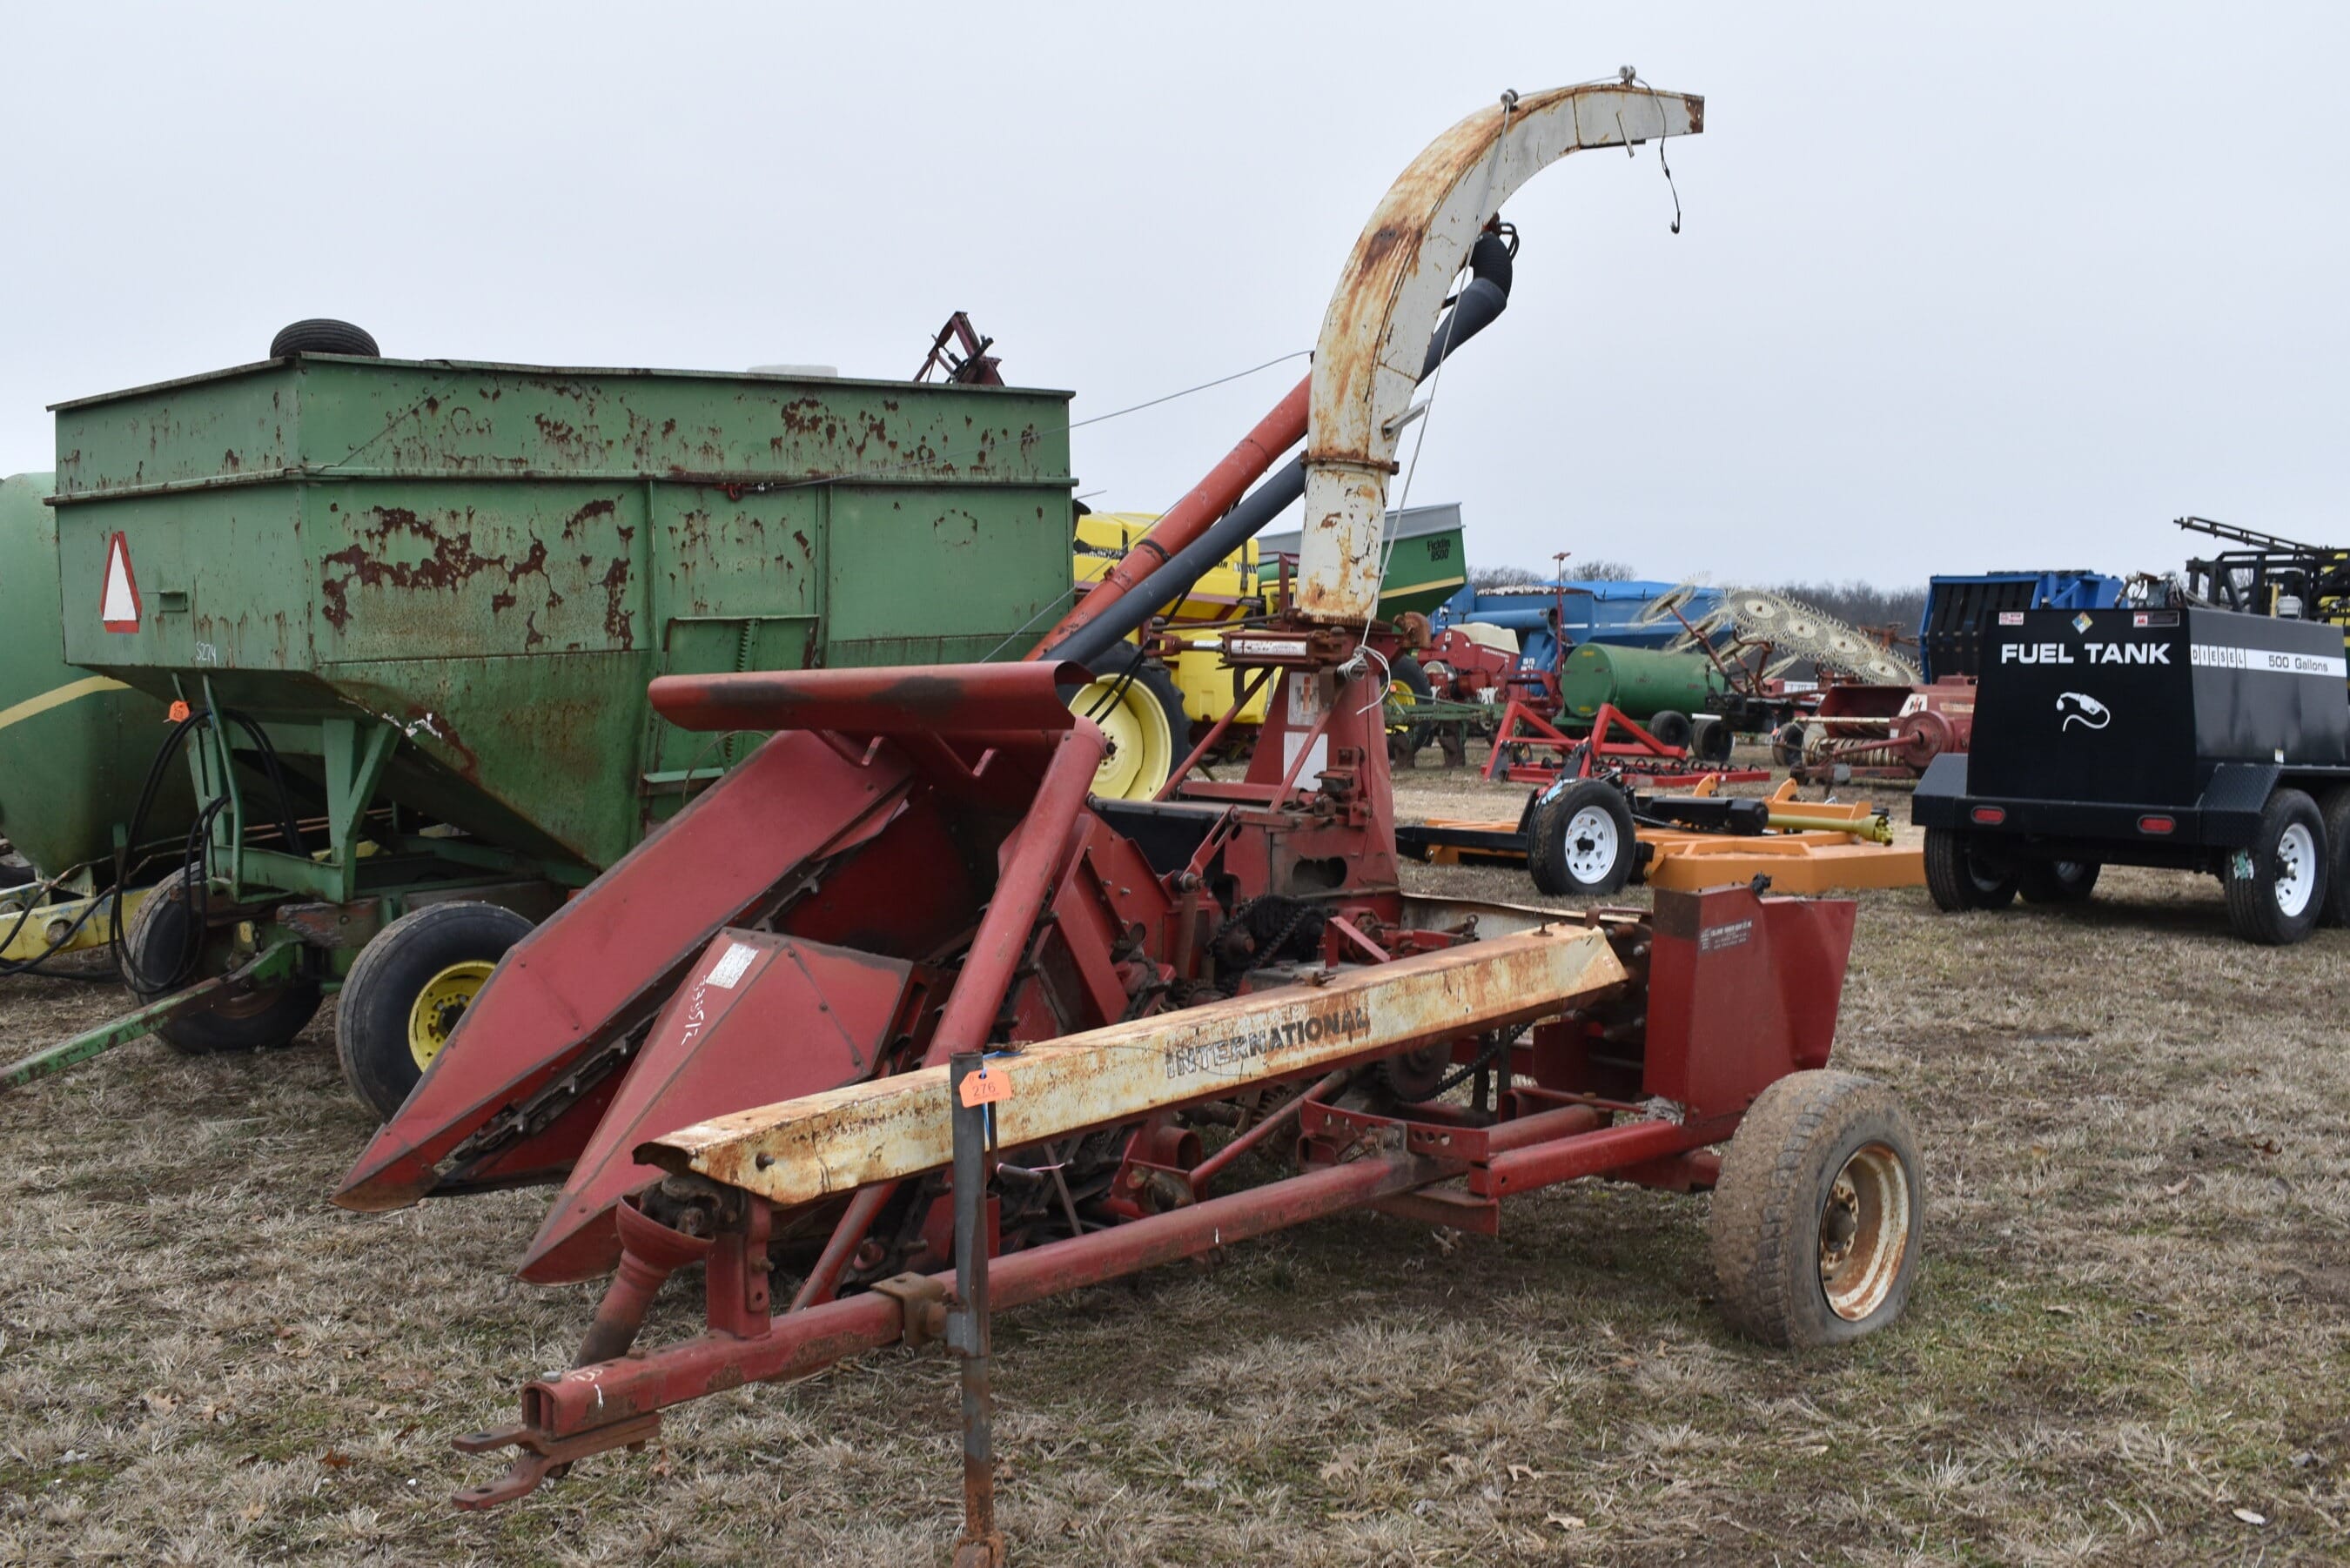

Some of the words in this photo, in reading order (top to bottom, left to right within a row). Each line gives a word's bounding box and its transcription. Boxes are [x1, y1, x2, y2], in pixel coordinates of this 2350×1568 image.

[2001, 642, 2075, 665] FUEL
[2084, 642, 2172, 665] TANK
[2192, 649, 2244, 665] DIESEL
[2268, 654, 2290, 668] 500
[2294, 657, 2329, 673] Gallons
[1164, 1006, 1371, 1079] INTERNATIONAL
[971, 1082, 997, 1097] 276
